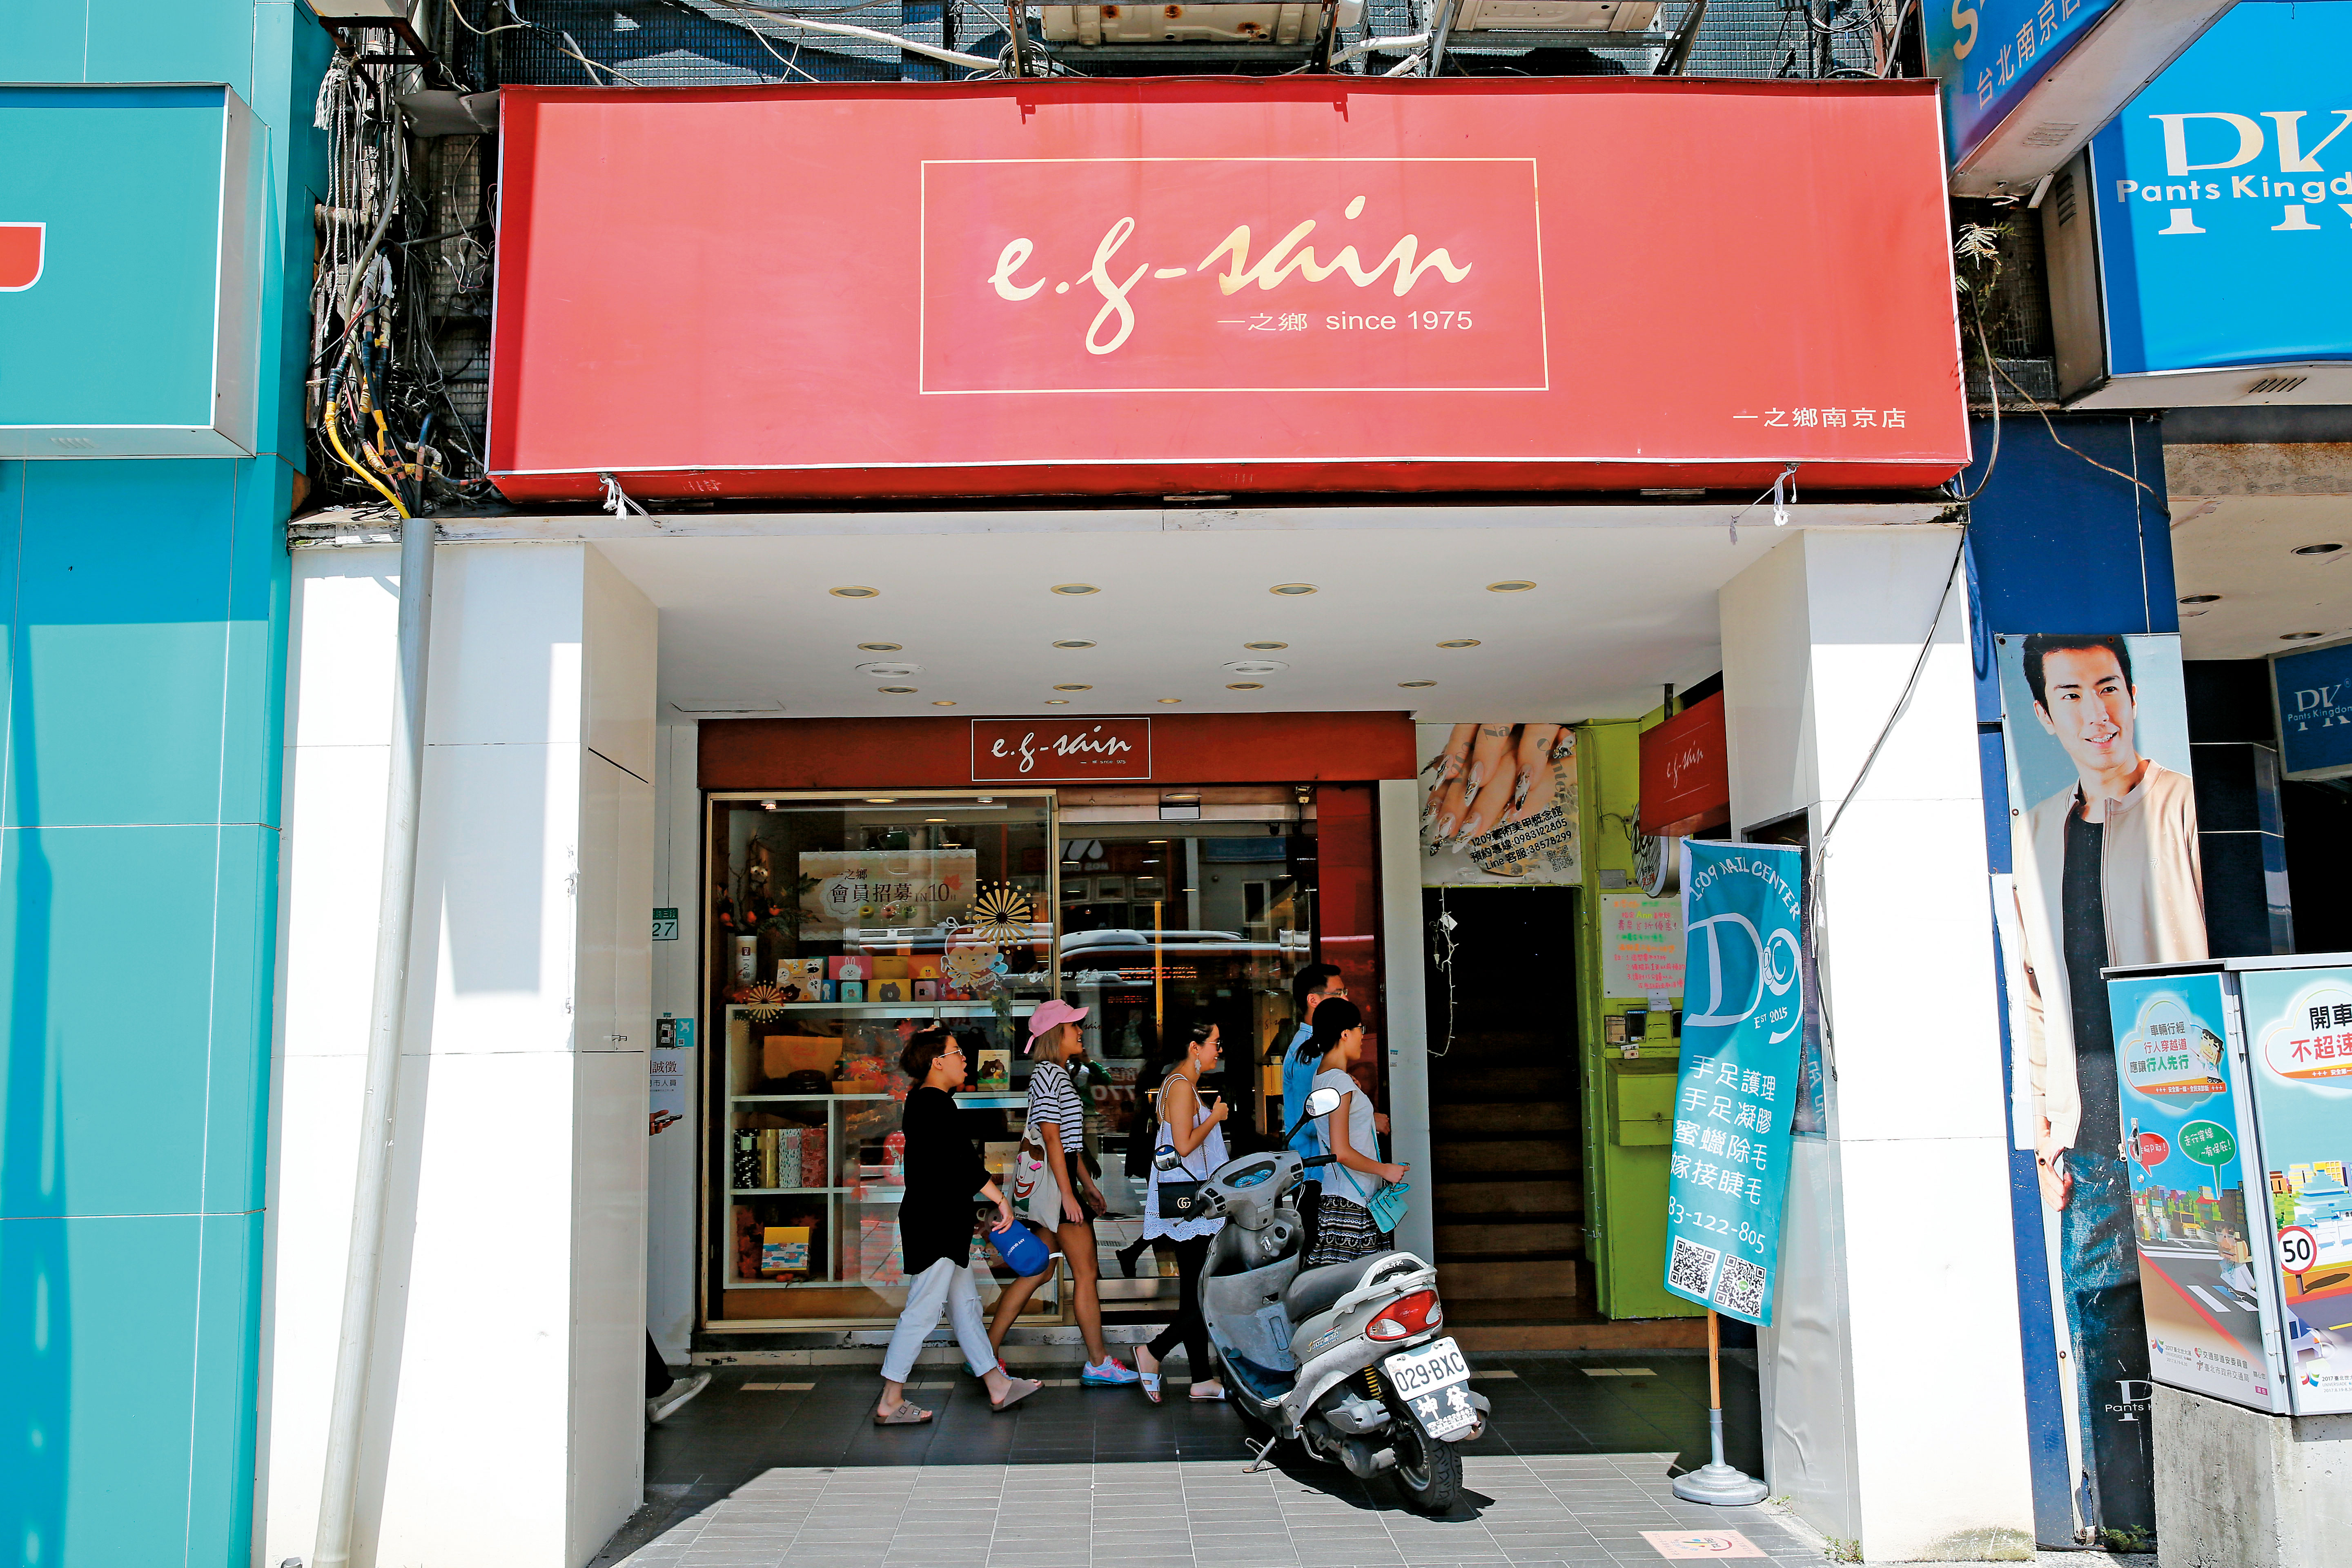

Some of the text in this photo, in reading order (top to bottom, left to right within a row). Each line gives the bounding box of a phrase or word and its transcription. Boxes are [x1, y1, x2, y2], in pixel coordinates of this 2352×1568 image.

[1952, 0, 1984, 60] S
[2116, 180, 2221, 203] Pants
[1217, 311, 1473, 332] 一之鄉 since 1975
[1733, 407, 1907, 429] 一之鄉南京店
[2288, 713, 2311, 722] Pants
[1485, 858, 1504, 870] Line
[833, 869, 867, 880] 一之鄉
[831, 883, 912, 903] 會員招募
[1751, 861, 1801, 921] CENTER
[653, 922, 675, 936] 27
[1769, 1006, 1788, 1024] 2015
[2309, 1004, 2352, 1031] 開車
[2150, 1021, 2185, 1036] 車輛行經
[2144, 1038, 2187, 1054] 行人穿越道
[2290, 1032, 2352, 1062] 不超速
[2130, 1054, 2189, 1073] 應讓行人先行
[1689, 1055, 1775, 1101] 手足護理
[1682, 1087, 1772, 1134] 手足凝膠
[1674, 1120, 1767, 1171] 蜜蠟除毛
[1670, 1151, 1762, 1205] 嫁接睫毛
[2283, 1238, 2310, 1263] 50
[2203, 1351, 2248, 1369] 交通部道安委員會
[2204, 1363, 2250, 1382] 臺北市政府交通局
[2105, 1403, 2144, 1412] Pants
